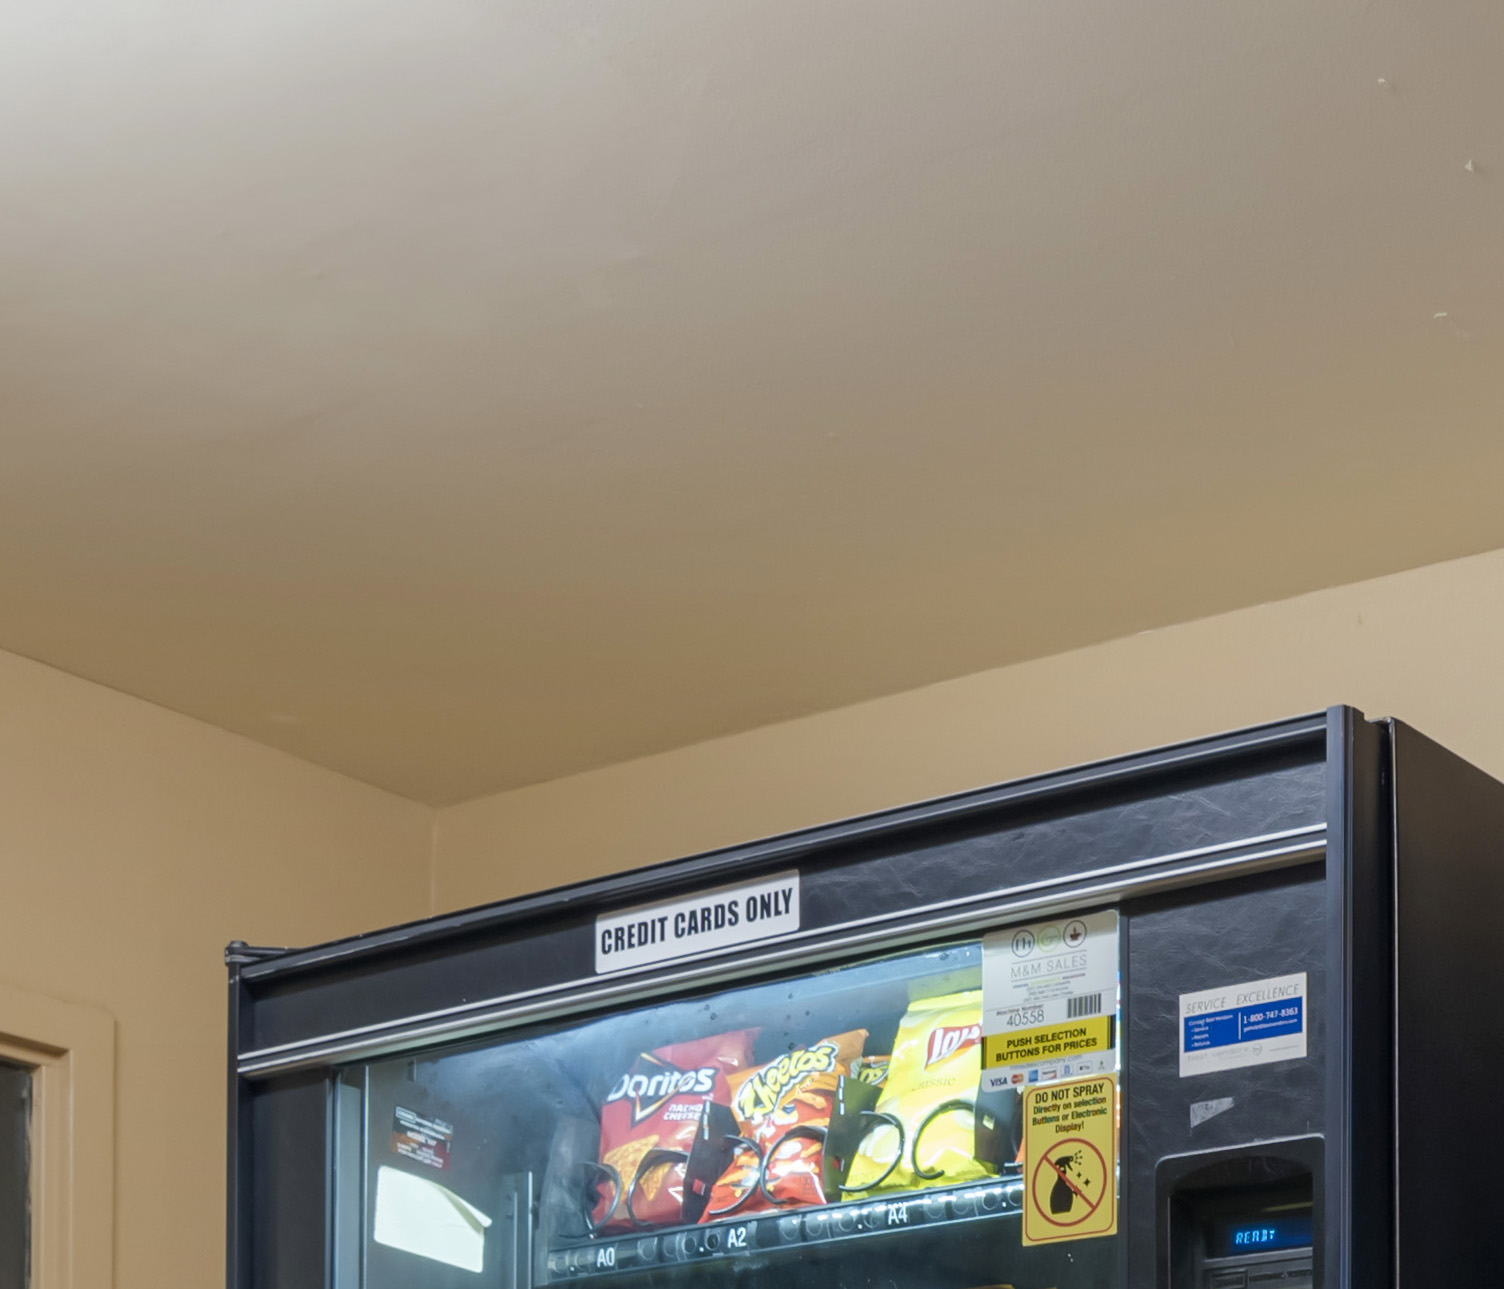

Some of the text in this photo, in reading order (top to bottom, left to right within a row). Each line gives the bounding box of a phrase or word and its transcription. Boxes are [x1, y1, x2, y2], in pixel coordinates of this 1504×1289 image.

[601, 887, 793, 955] CREDIT CARDS ONLY
[1011, 954, 1088, 980] M&M SALES
[1186, 984, 1300, 1015] SERVICE EXCELLENCE
[1006, 1009, 1045, 1027] 40558
[1006, 1027, 1087, 1049] PUSH SELECTION
[996, 1046, 1040, 1062] BUTTONS
[1042, 1043, 1061, 1055] FOR
[1063, 1037, 1098, 1052] PRICES
[607, 1067, 717, 1102] Doritos
[989, 1076, 1008, 1087] VISA
[1035, 1082, 1104, 1104] DO NOT SPRAY
[1032, 1115, 1060, 1126] Buttons
[1071, 1106, 1107, 1120] Electronic
[1033, 1096, 1107, 1115] Directly on selection
[1055, 1120, 1084, 1133] Display!
[887, 1204, 908, 1226] A4
[597, 1248, 615, 1267] A0
